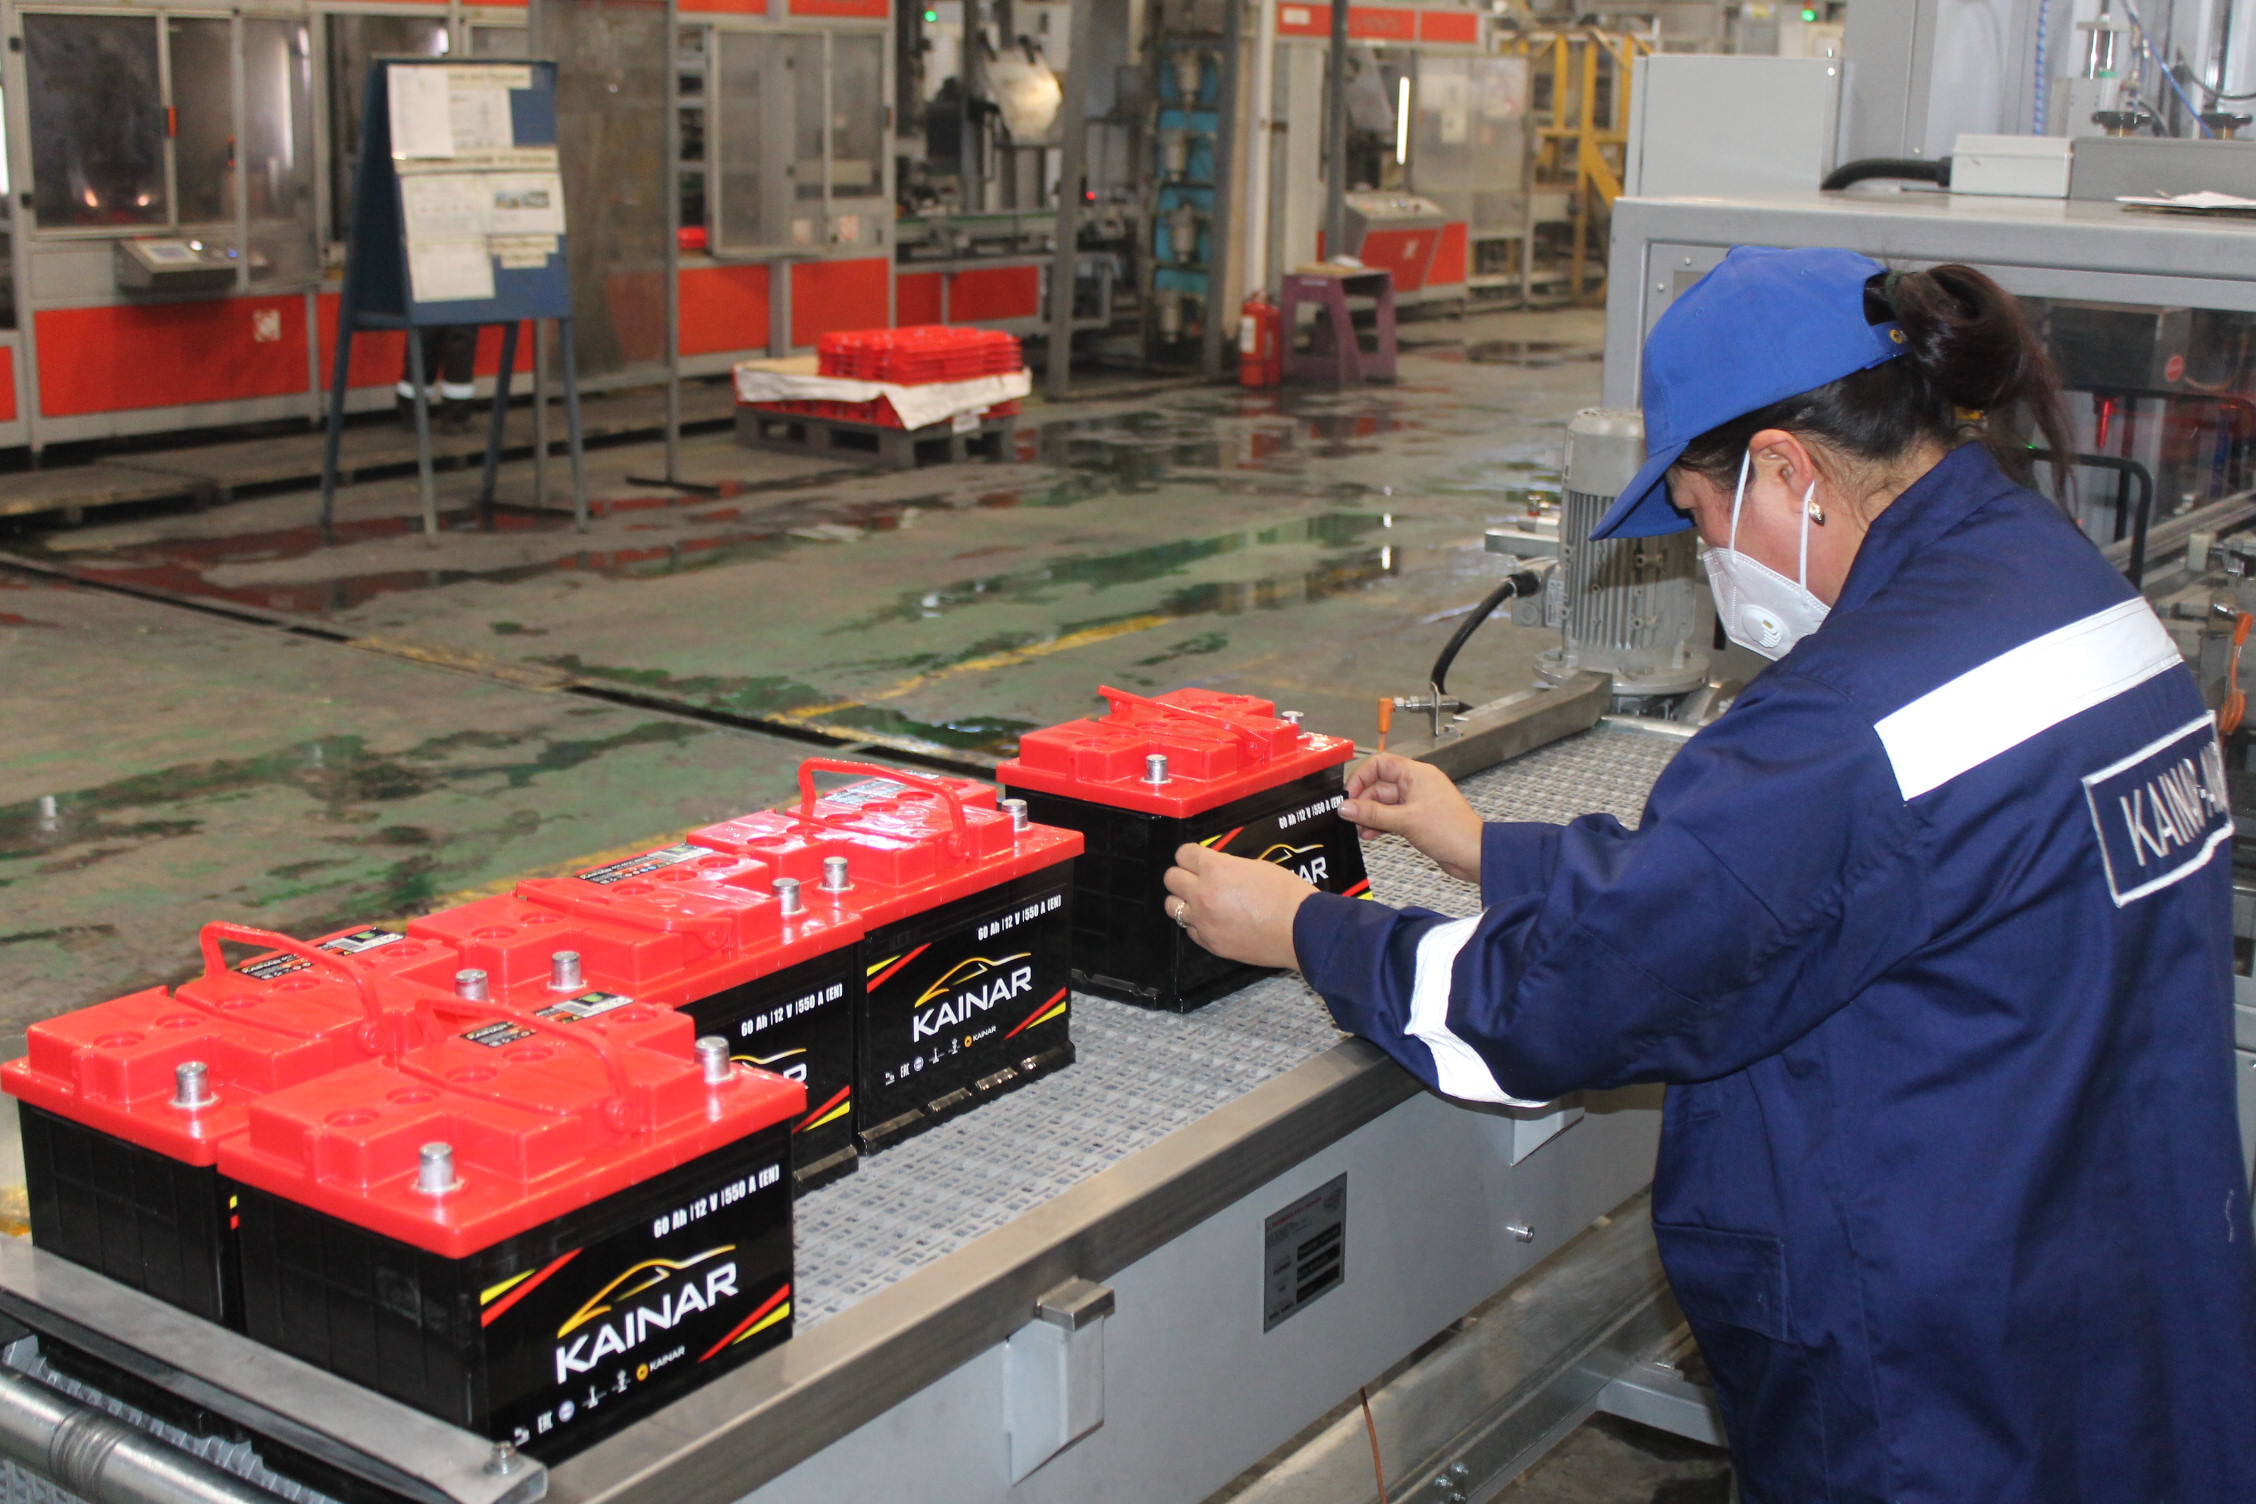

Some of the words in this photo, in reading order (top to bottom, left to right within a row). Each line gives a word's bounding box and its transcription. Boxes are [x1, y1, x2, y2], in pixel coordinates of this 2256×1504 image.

[977, 925, 989, 941] 60
[990, 921, 1000, 936] Ah
[1014, 911, 1021, 925] V
[1040, 901, 1046, 915] A
[741, 1019, 754, 1037] 60
[755, 1014, 768, 1032] Ah
[785, 1003, 793, 1019] V
[817, 991, 824, 1006] A
[912, 966, 1033, 1043] KAINAR
[973, 1025, 997, 1042] KAINAR
[653, 1215, 670, 1239] 60
[672, 1208, 688, 1231] Ah
[709, 1193, 718, 1212] V
[748, 1175, 757, 1194] A
[556, 1261, 740, 1385] KAINAR
[649, 1345, 686, 1372] KAINAR
